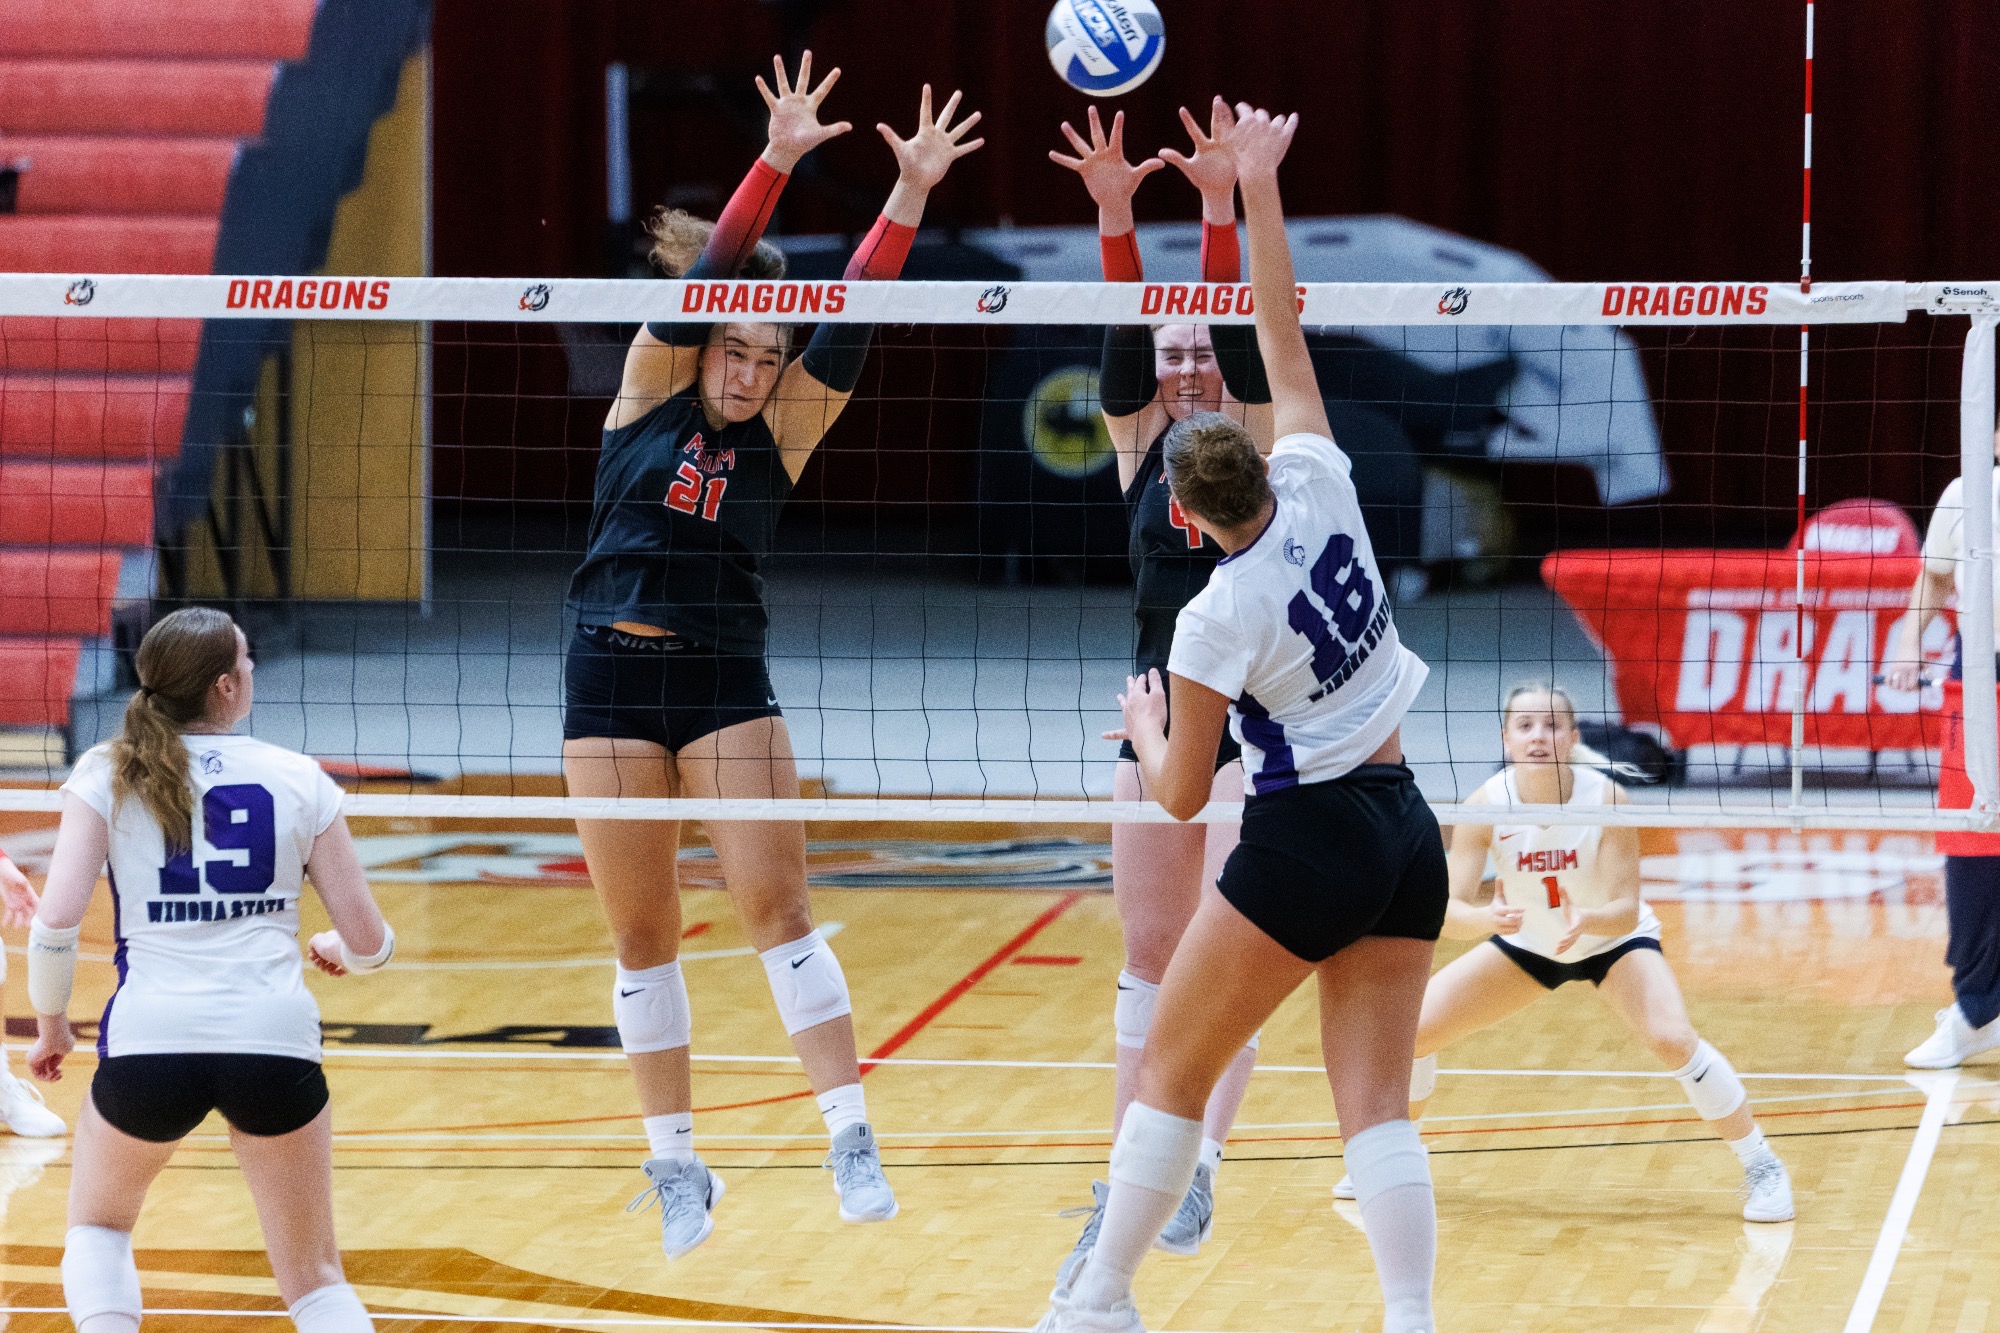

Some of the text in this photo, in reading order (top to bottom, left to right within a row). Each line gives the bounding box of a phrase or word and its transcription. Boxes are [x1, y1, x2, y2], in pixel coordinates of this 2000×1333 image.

[1107, 0, 1139, 41] olten
[226, 280, 390, 310] DRAGONS
[682, 284, 847, 313] DRAGONS
[1140, 285, 1307, 315] DRAGO
[1601, 285, 1769, 316] DRAGONS
[1953, 288, 1988, 296] Senoh
[683, 432, 735, 474] MSUM
[663, 461, 727, 522] 21
[1287, 533, 1374, 685] 16
[158, 784, 275, 895] 19
[1517, 849, 1578, 873] MSUM
[1541, 876, 1561, 909] 1
[146, 901, 227, 923] WINONA
